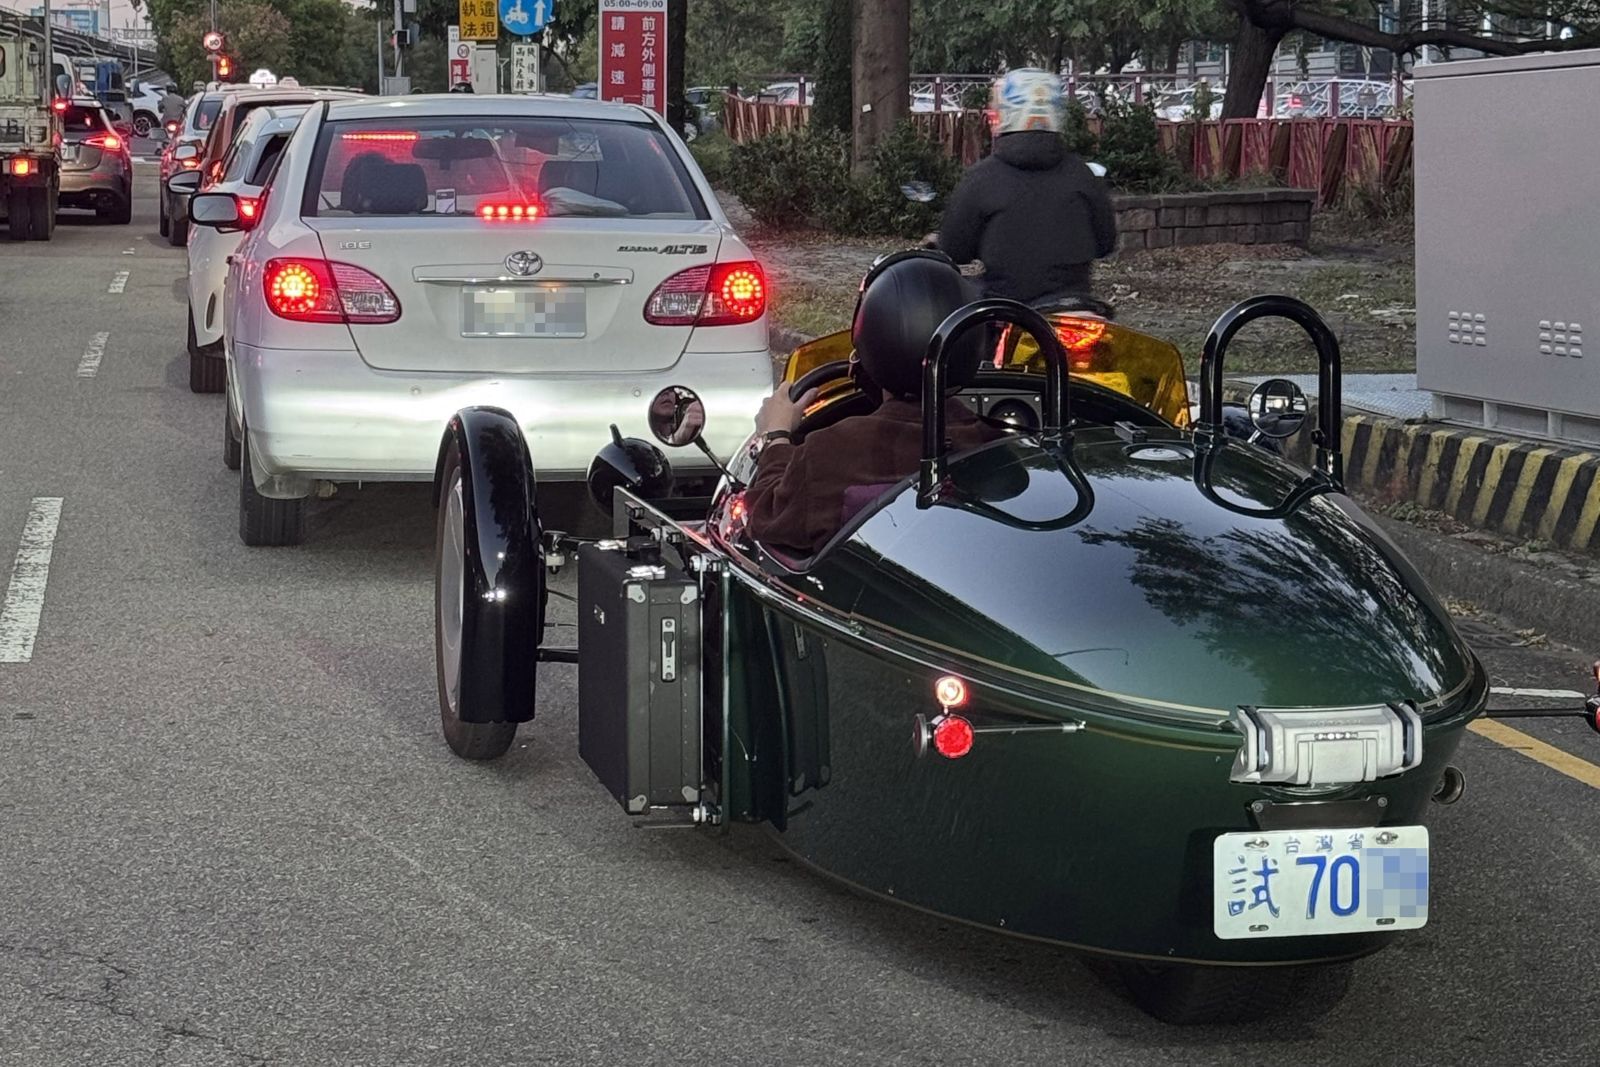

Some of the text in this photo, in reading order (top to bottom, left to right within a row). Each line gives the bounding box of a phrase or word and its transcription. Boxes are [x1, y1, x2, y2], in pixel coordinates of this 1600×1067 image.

[462, 1, 477, 37] 執法
[641, 16, 656, 108] 前方外側車道
[1284, 833, 1364, 854] 台灣省
[1227, 855, 1280, 918] 試
